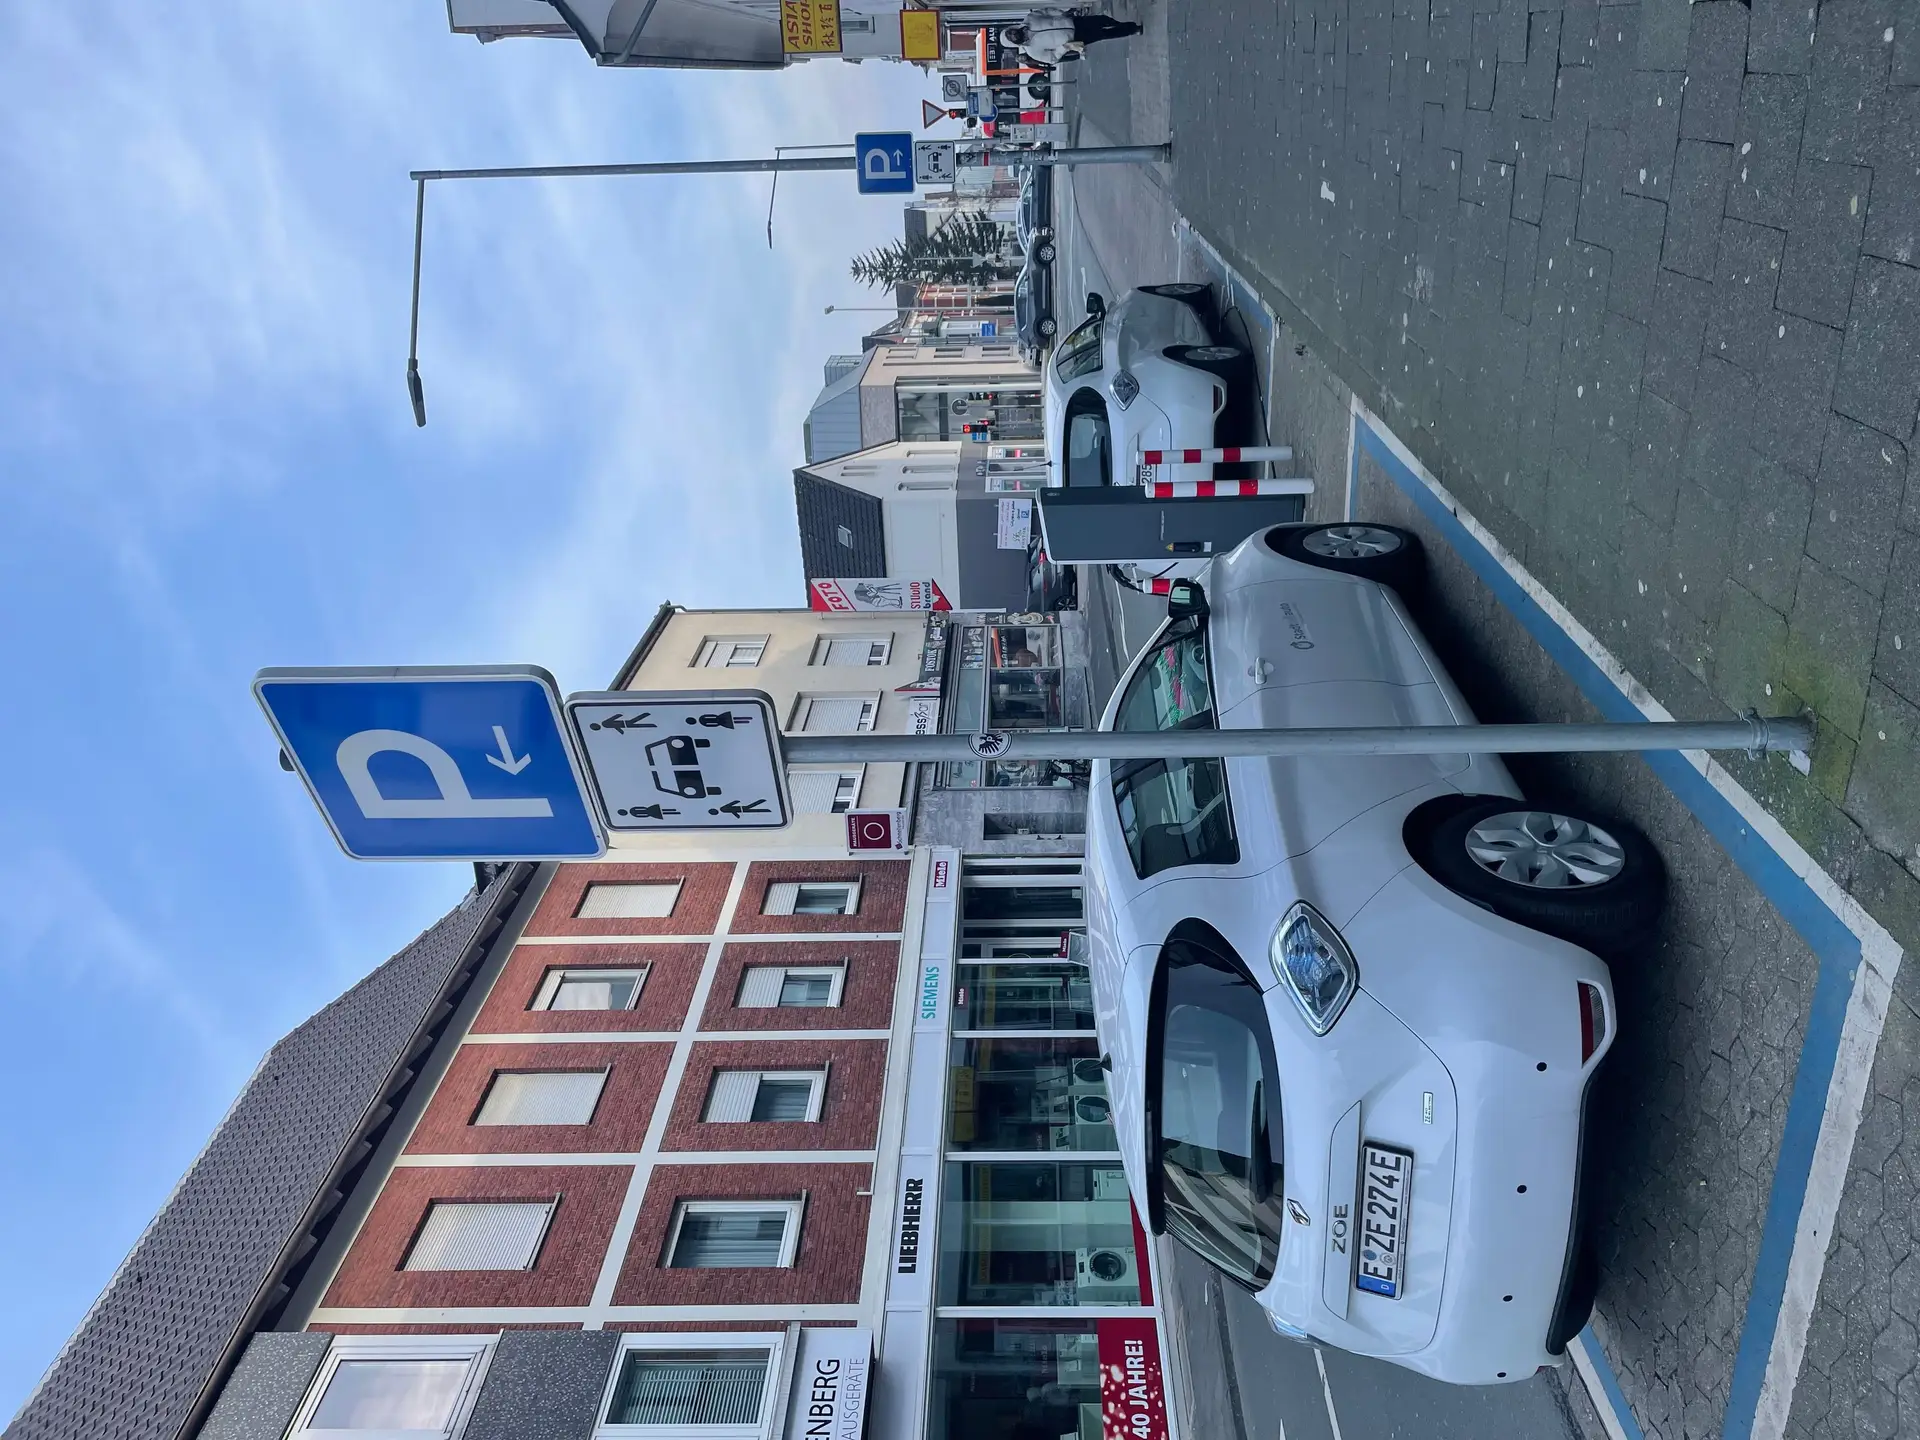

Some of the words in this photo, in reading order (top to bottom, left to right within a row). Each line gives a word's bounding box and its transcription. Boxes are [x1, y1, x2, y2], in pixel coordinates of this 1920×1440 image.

[785, 0, 800, 50] ASIA
[864, 148, 907, 180] P
[817, 582, 849, 610] FOTO
[910, 582, 921, 609] STUDIO
[921, 581, 931, 609] brand
[925, 649, 937, 672] FOSTOK
[336, 729, 554, 819] P
[935, 861, 947, 887] Miele
[921, 966, 939, 1019] SIEMENS
[897, 1178, 923, 1274] LIEBHERR
[1332, 1204, 1348, 1254] ZOE
[1124, 1340, 1149, 1410] JAHRE!
[805, 1359, 840, 1440] NBERG
[1131, 1413, 1151, 1439] 40
